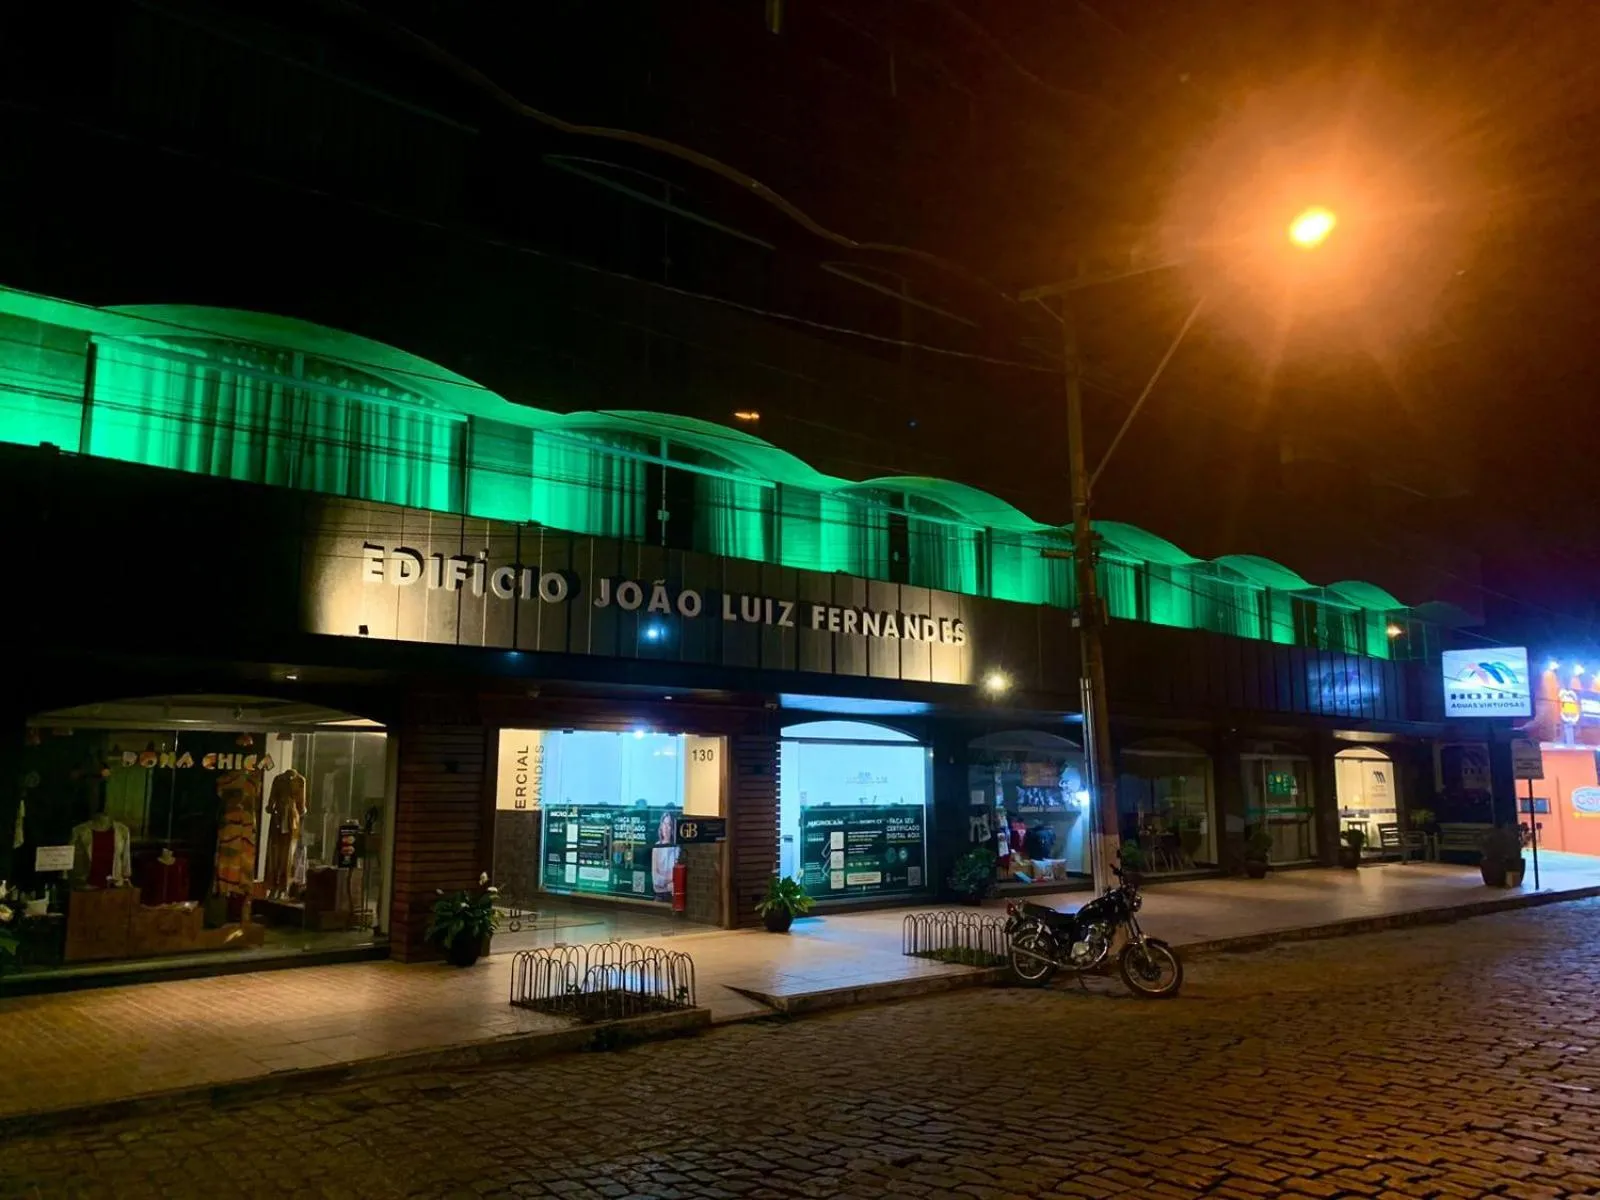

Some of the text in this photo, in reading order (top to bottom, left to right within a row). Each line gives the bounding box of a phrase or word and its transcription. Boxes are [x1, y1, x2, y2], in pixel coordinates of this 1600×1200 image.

[362, 547, 967, 648] EDIFÍCIO JOÃO LUIZ FERNANDES
[121, 750, 275, 771] DONA CHICA
[692, 748, 714, 762] 130
